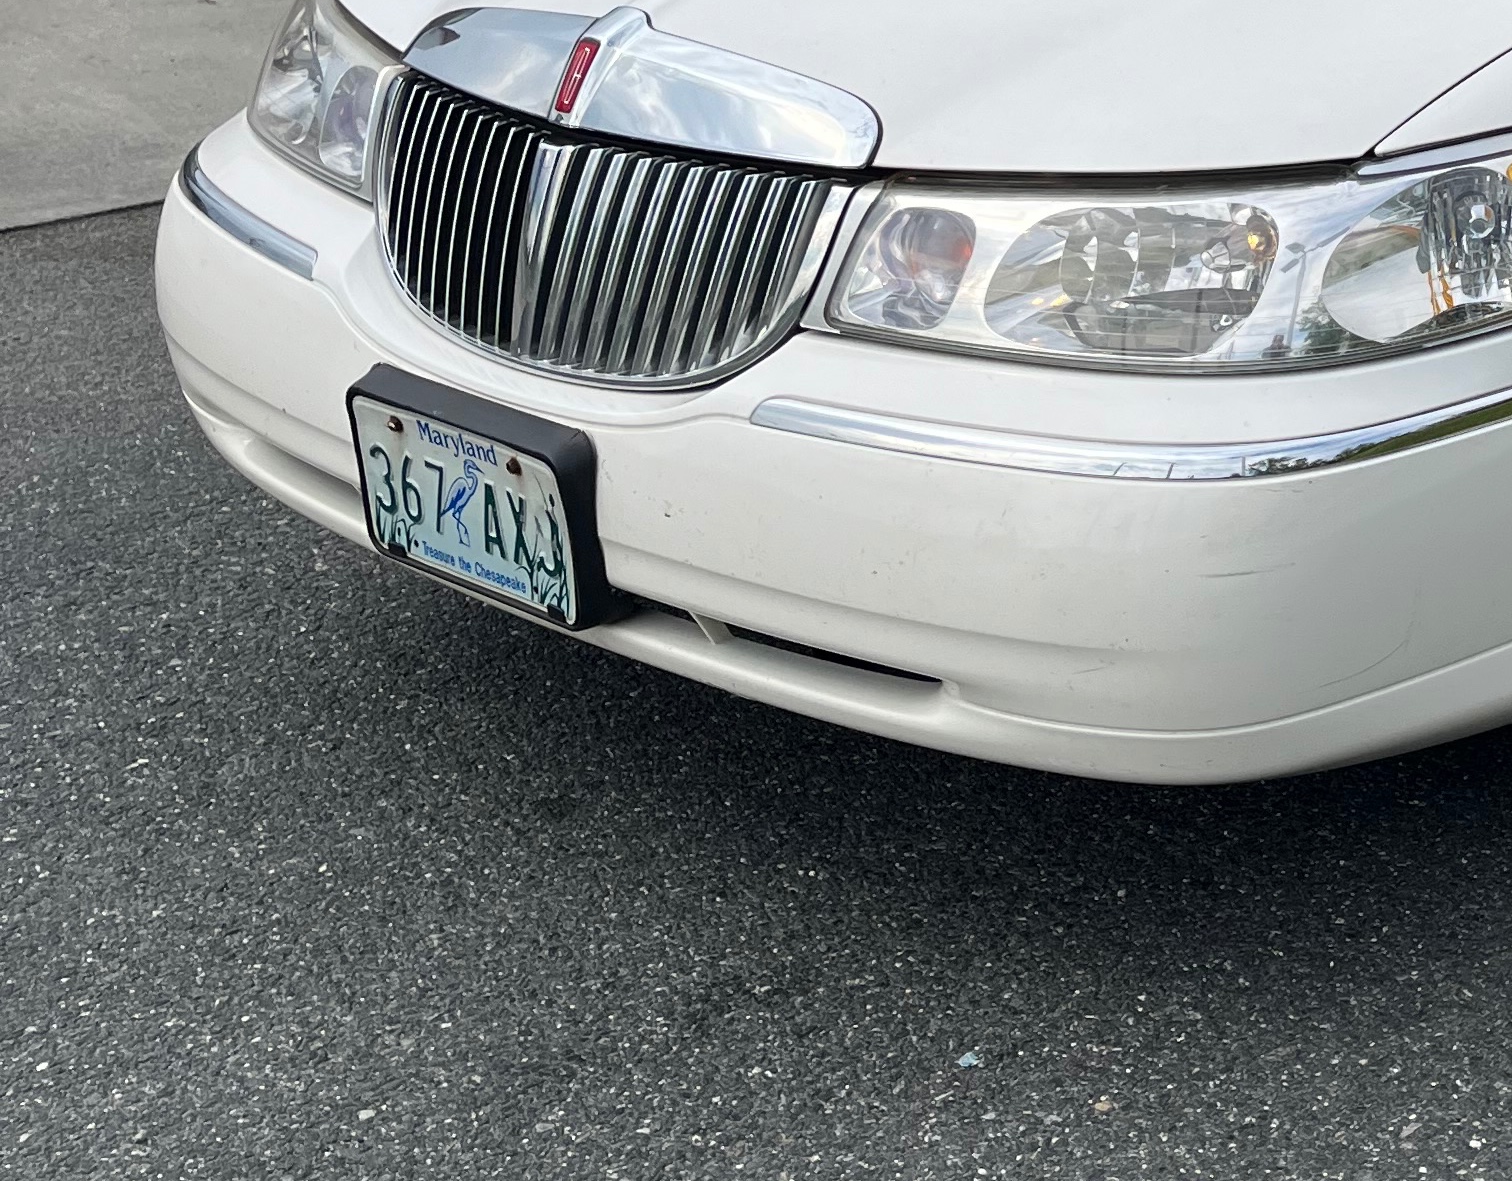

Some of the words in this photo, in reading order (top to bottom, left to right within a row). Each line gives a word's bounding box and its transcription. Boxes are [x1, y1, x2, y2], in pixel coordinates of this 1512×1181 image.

[416, 419, 498, 467] Maryland
[370, 443, 444, 535] 367
[421, 540, 456, 567] Treasure
[458, 555, 471, 573] the
[474, 561, 526, 594] Chesapeake
